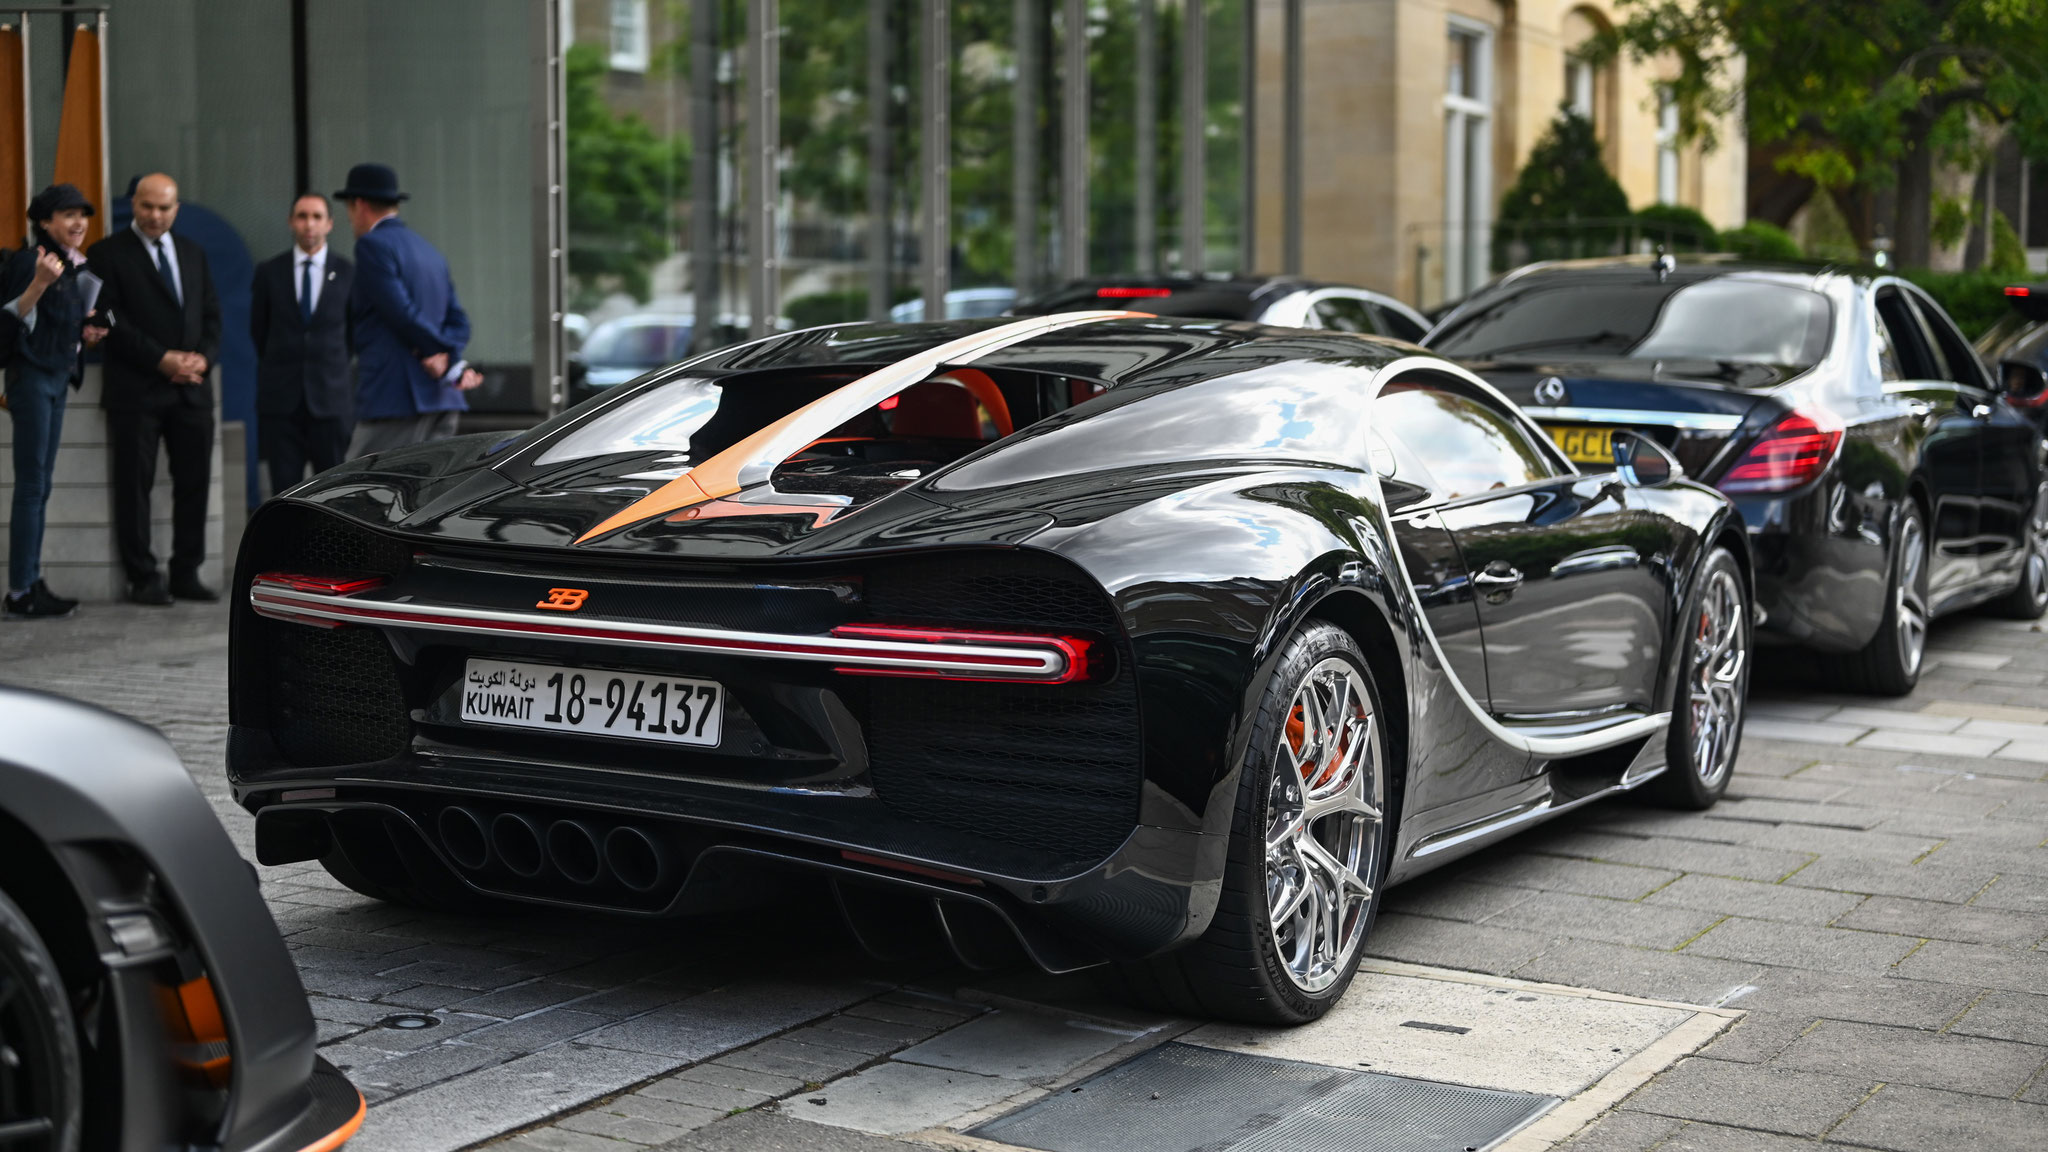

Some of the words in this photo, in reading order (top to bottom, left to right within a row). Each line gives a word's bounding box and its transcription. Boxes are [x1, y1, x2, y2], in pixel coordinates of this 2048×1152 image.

[468, 670, 506, 689] الكويت
[509, 668, 536, 692] دولة
[465, 691, 535, 720] KUWAIT
[544, 672, 717, 737] 18-94137
[1265, 955, 1297, 1004] MICHELIN
